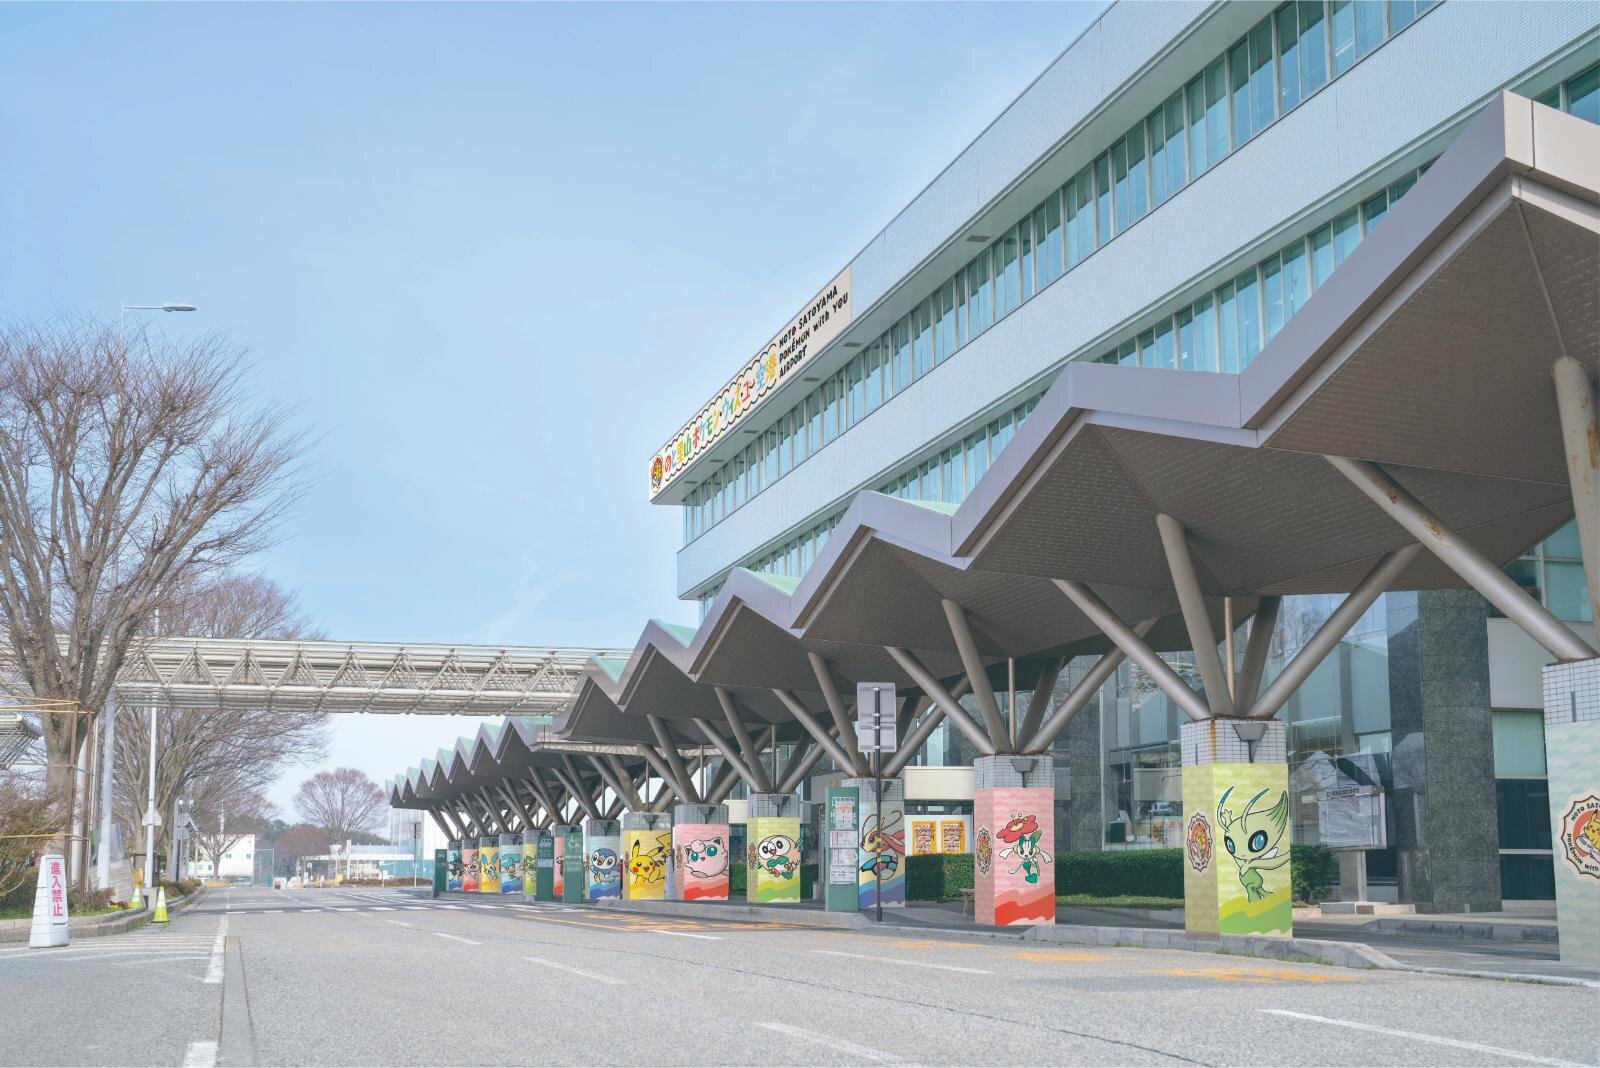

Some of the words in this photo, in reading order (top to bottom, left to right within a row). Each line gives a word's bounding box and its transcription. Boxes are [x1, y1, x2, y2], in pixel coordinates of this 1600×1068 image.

[779, 326, 796, 348] NOTO
[798, 285, 837, 329] SATOYAMA
[779, 328, 810, 364] POKÉMON
[813, 310, 829, 331] with
[832, 292, 848, 313] YOU
[779, 345, 807, 378] AIRPORT
[1571, 806, 1585, 822] NOTO
[50, 861, 64, 917] 進入禁止
[1584, 863, 1599, 872] with
